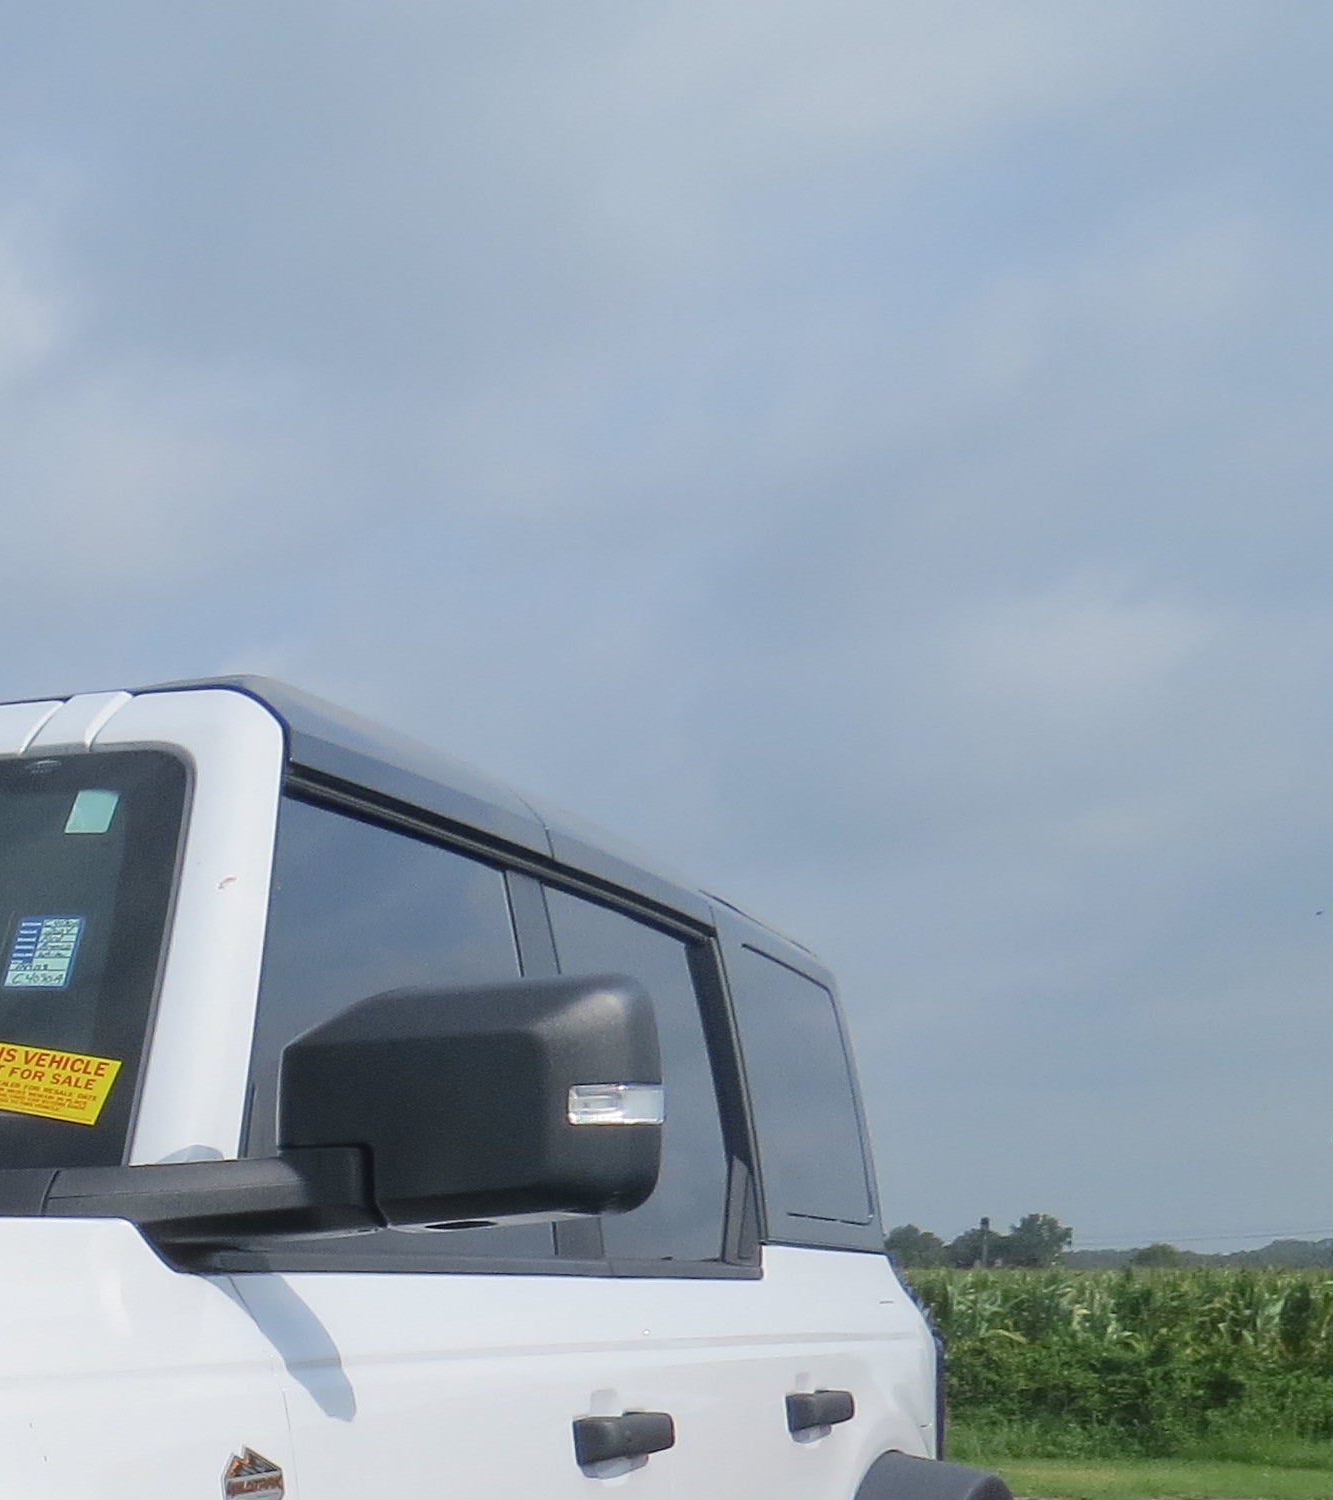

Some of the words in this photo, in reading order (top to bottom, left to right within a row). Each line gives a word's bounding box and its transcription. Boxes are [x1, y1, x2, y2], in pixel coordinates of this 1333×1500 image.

[24, 1051, 110, 1077] VEHICLE
[8, 1067, 45, 1082] FOR
[50, 1073, 96, 1091] SALE
